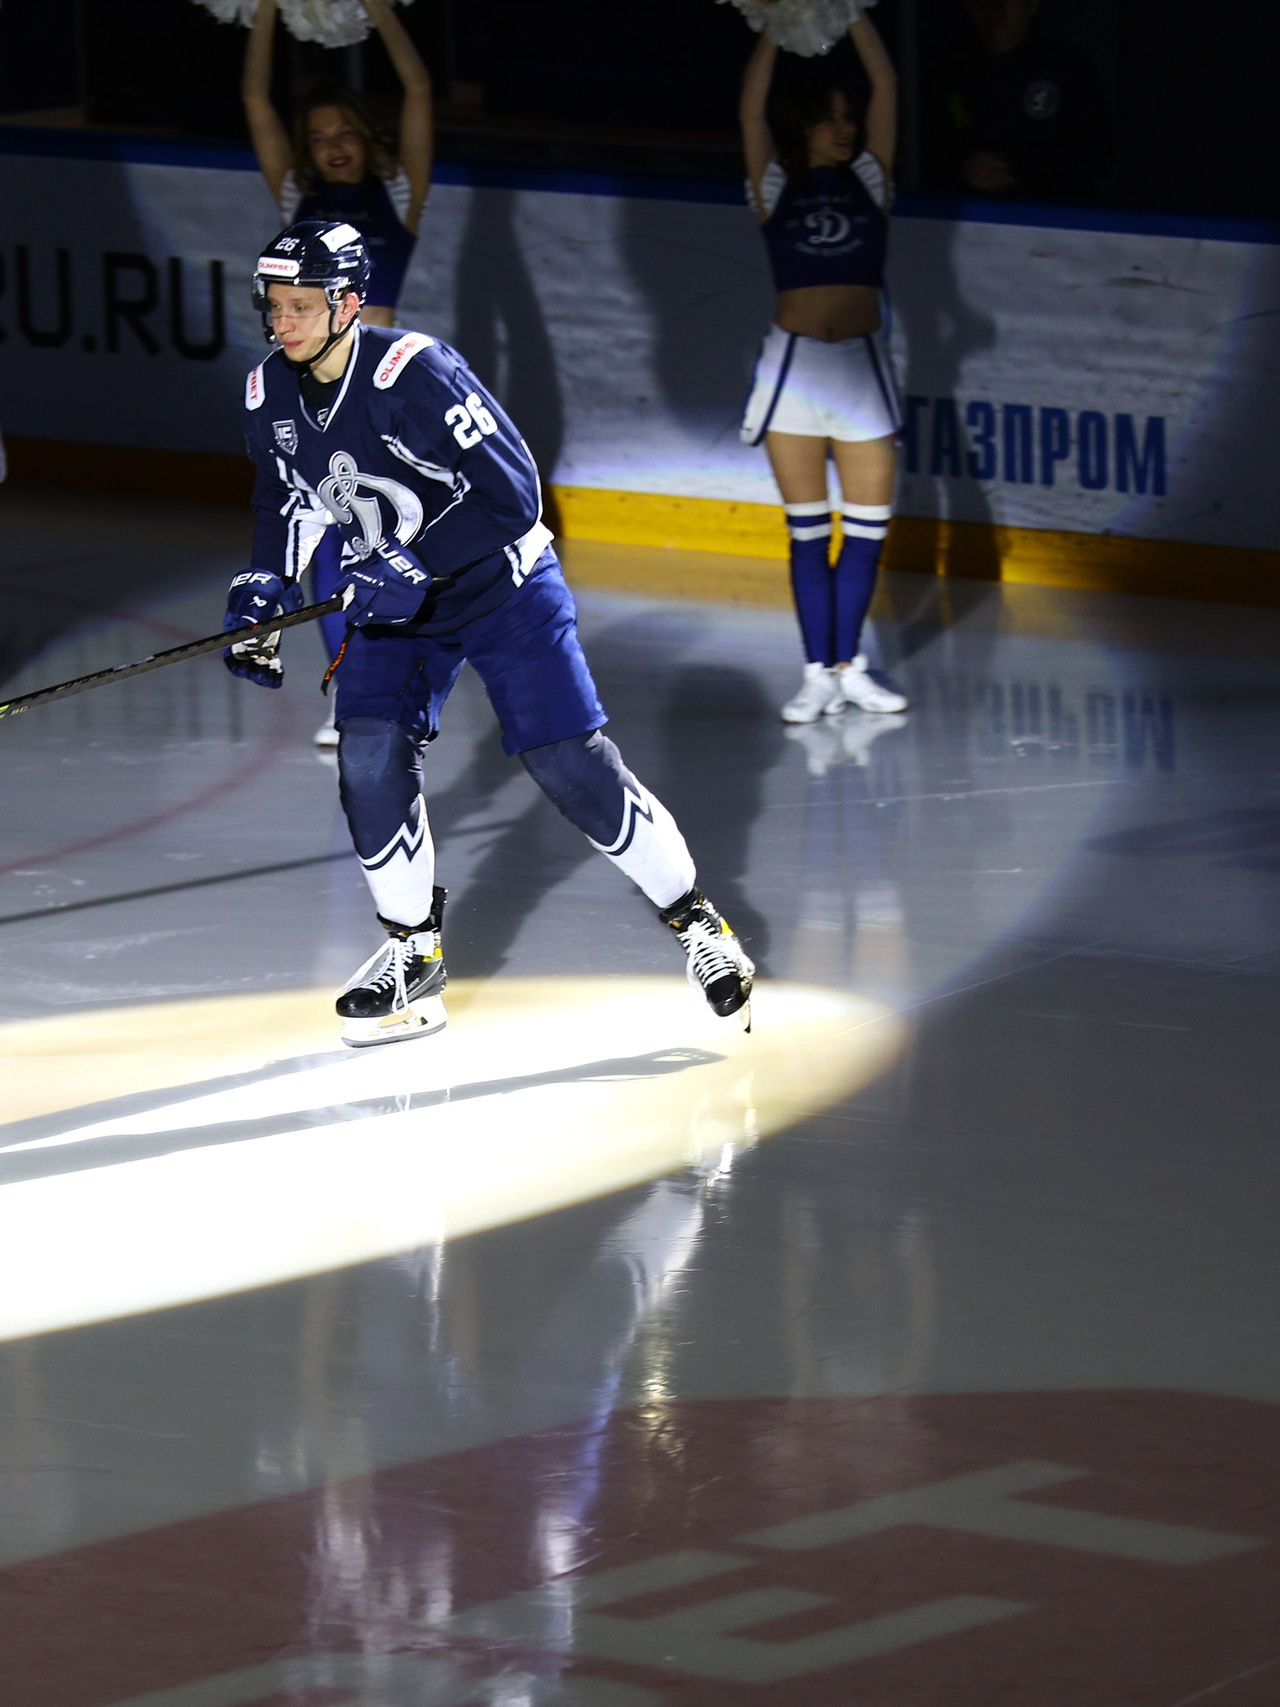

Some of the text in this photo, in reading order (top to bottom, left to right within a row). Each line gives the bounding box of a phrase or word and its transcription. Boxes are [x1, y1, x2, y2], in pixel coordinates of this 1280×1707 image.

[274, 236, 297, 251] 26
[444, 391, 498, 450] 26
[905, 395, 1166, 496] ГАЗПРОМ
[374, 537, 428, 585] UER
